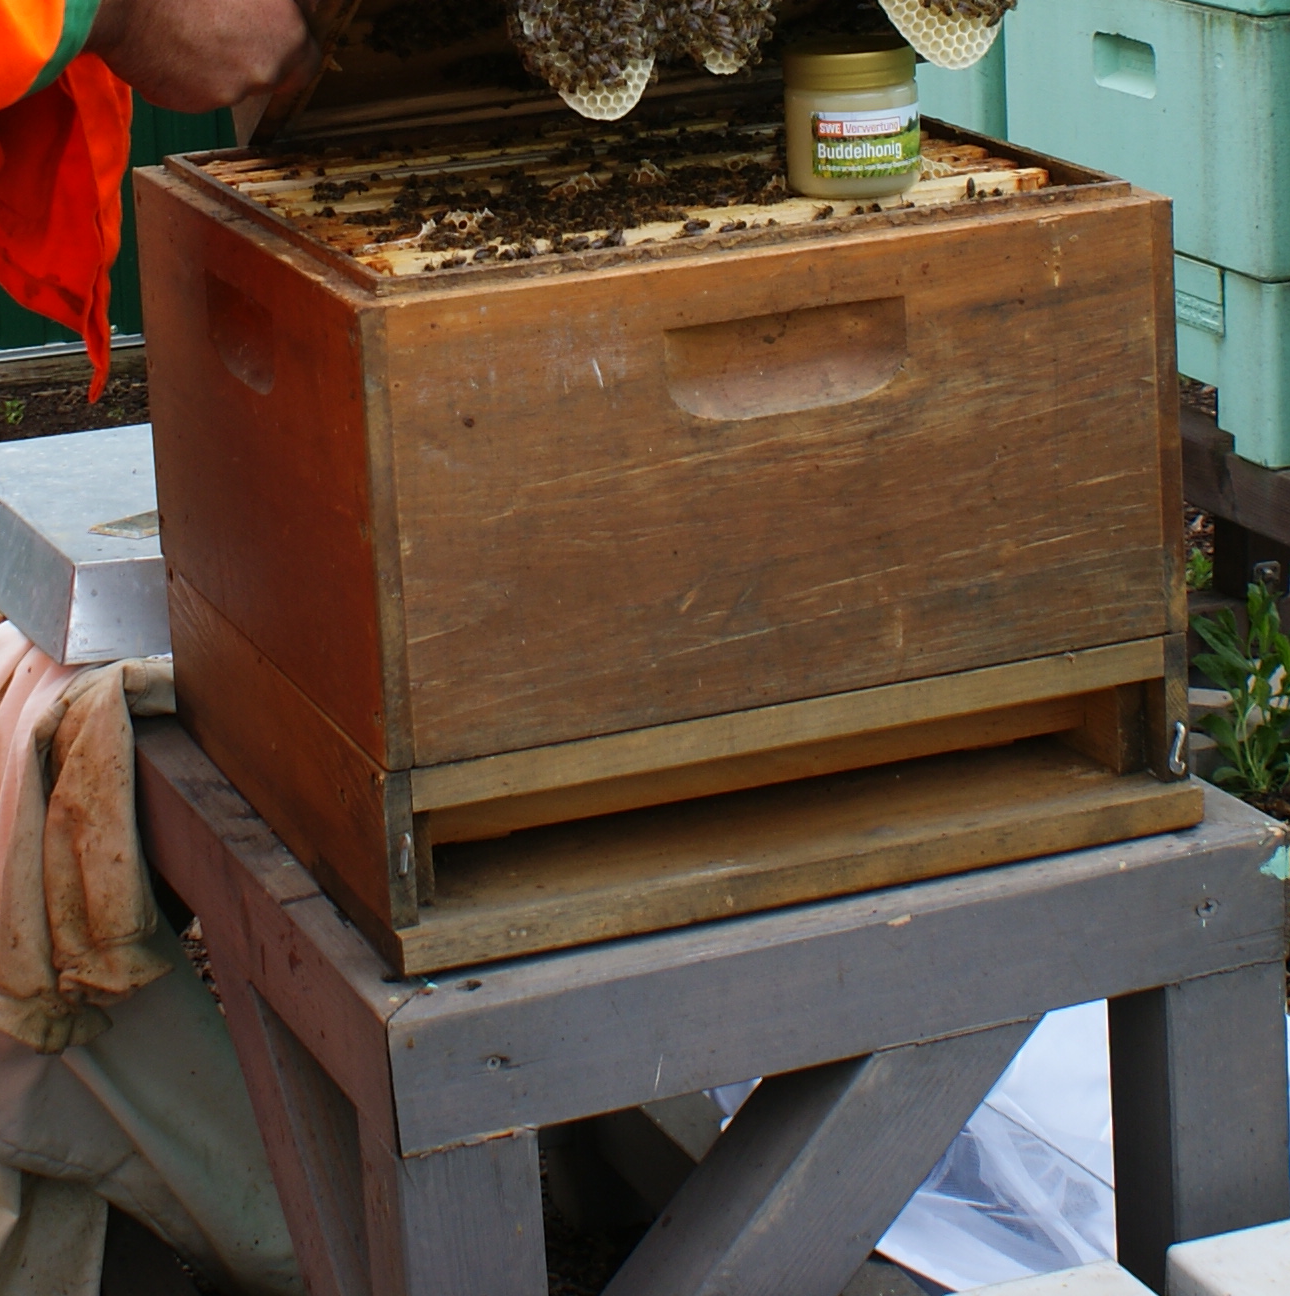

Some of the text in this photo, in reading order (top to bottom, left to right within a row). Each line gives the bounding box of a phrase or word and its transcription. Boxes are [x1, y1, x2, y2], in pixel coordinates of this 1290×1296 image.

[819, 121, 899, 134] SWE Verwertung
[817, 141, 903, 160] Buddelhonig
